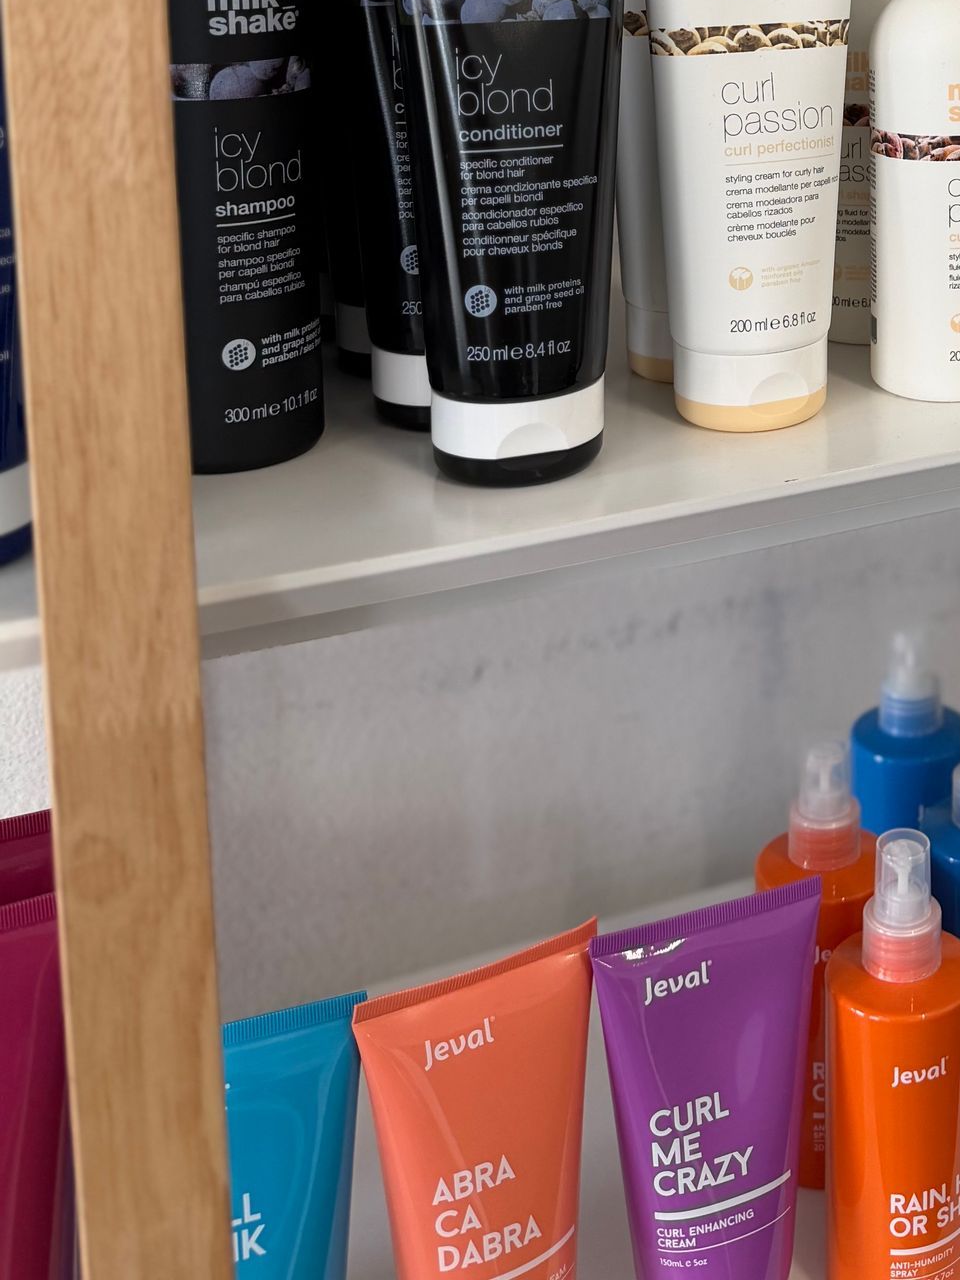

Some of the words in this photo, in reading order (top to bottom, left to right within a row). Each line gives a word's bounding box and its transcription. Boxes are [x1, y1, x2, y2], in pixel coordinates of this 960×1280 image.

[209, 7, 297, 37] shake
[456, 47, 503, 87] icy
[457, 78, 554, 118] blond
[721, 71, 776, 105] curl
[459, 123, 564, 142] conditioner
[723, 100, 834, 143] passion
[214, 126, 263, 163] icy
[724, 141, 753, 157] curl
[757, 134, 835, 157] perfectionist
[215, 149, 303, 192] blond
[460, 159, 498, 170] specific
[499, 154, 555, 167] conditioner
[725, 173, 753, 185] styling
[754, 171, 781, 182] cream
[782, 168, 794, 178] for
[461, 185, 494, 196] crema
[494, 179, 562, 194] condizionante
[562, 174, 599, 188] specifica
[215, 195, 296, 218] shampoo
[217, 231, 255, 245] specific
[256, 224, 296, 240] shampoo
[729, 319, 753, 333] 200
[782, 314, 799, 329] 6.8
[466, 346, 491, 362] 250
[526, 341, 545, 358] 8.4
[225, 406, 250, 424] 300
[644, 960, 711, 1007] Jeval
[425, 1018, 496, 1072] Jeval
[891, 1057, 948, 1088] Jeval
[649, 1091, 730, 1138] CURL
[651, 1131, 703, 1168] ME
[432, 1154, 517, 1206] ABRA
[653, 1145, 755, 1198] CRAZY
[890, 1183, 951, 1215] RAIN,
[434, 1204, 482, 1238] CA
[656, 1226, 686, 1238] CURL
[689, 1208, 755, 1236] ENHANCING
[890, 1215, 928, 1238] OR
[438, 1214, 543, 1273] DABRA
[657, 1237, 697, 1249] CREAM
[659, 1257, 684, 1269] 150mL
[890, 1247, 954, 1270] ANTI-HUMIDITY
[890, 1269, 918, 1278] SPRAY
